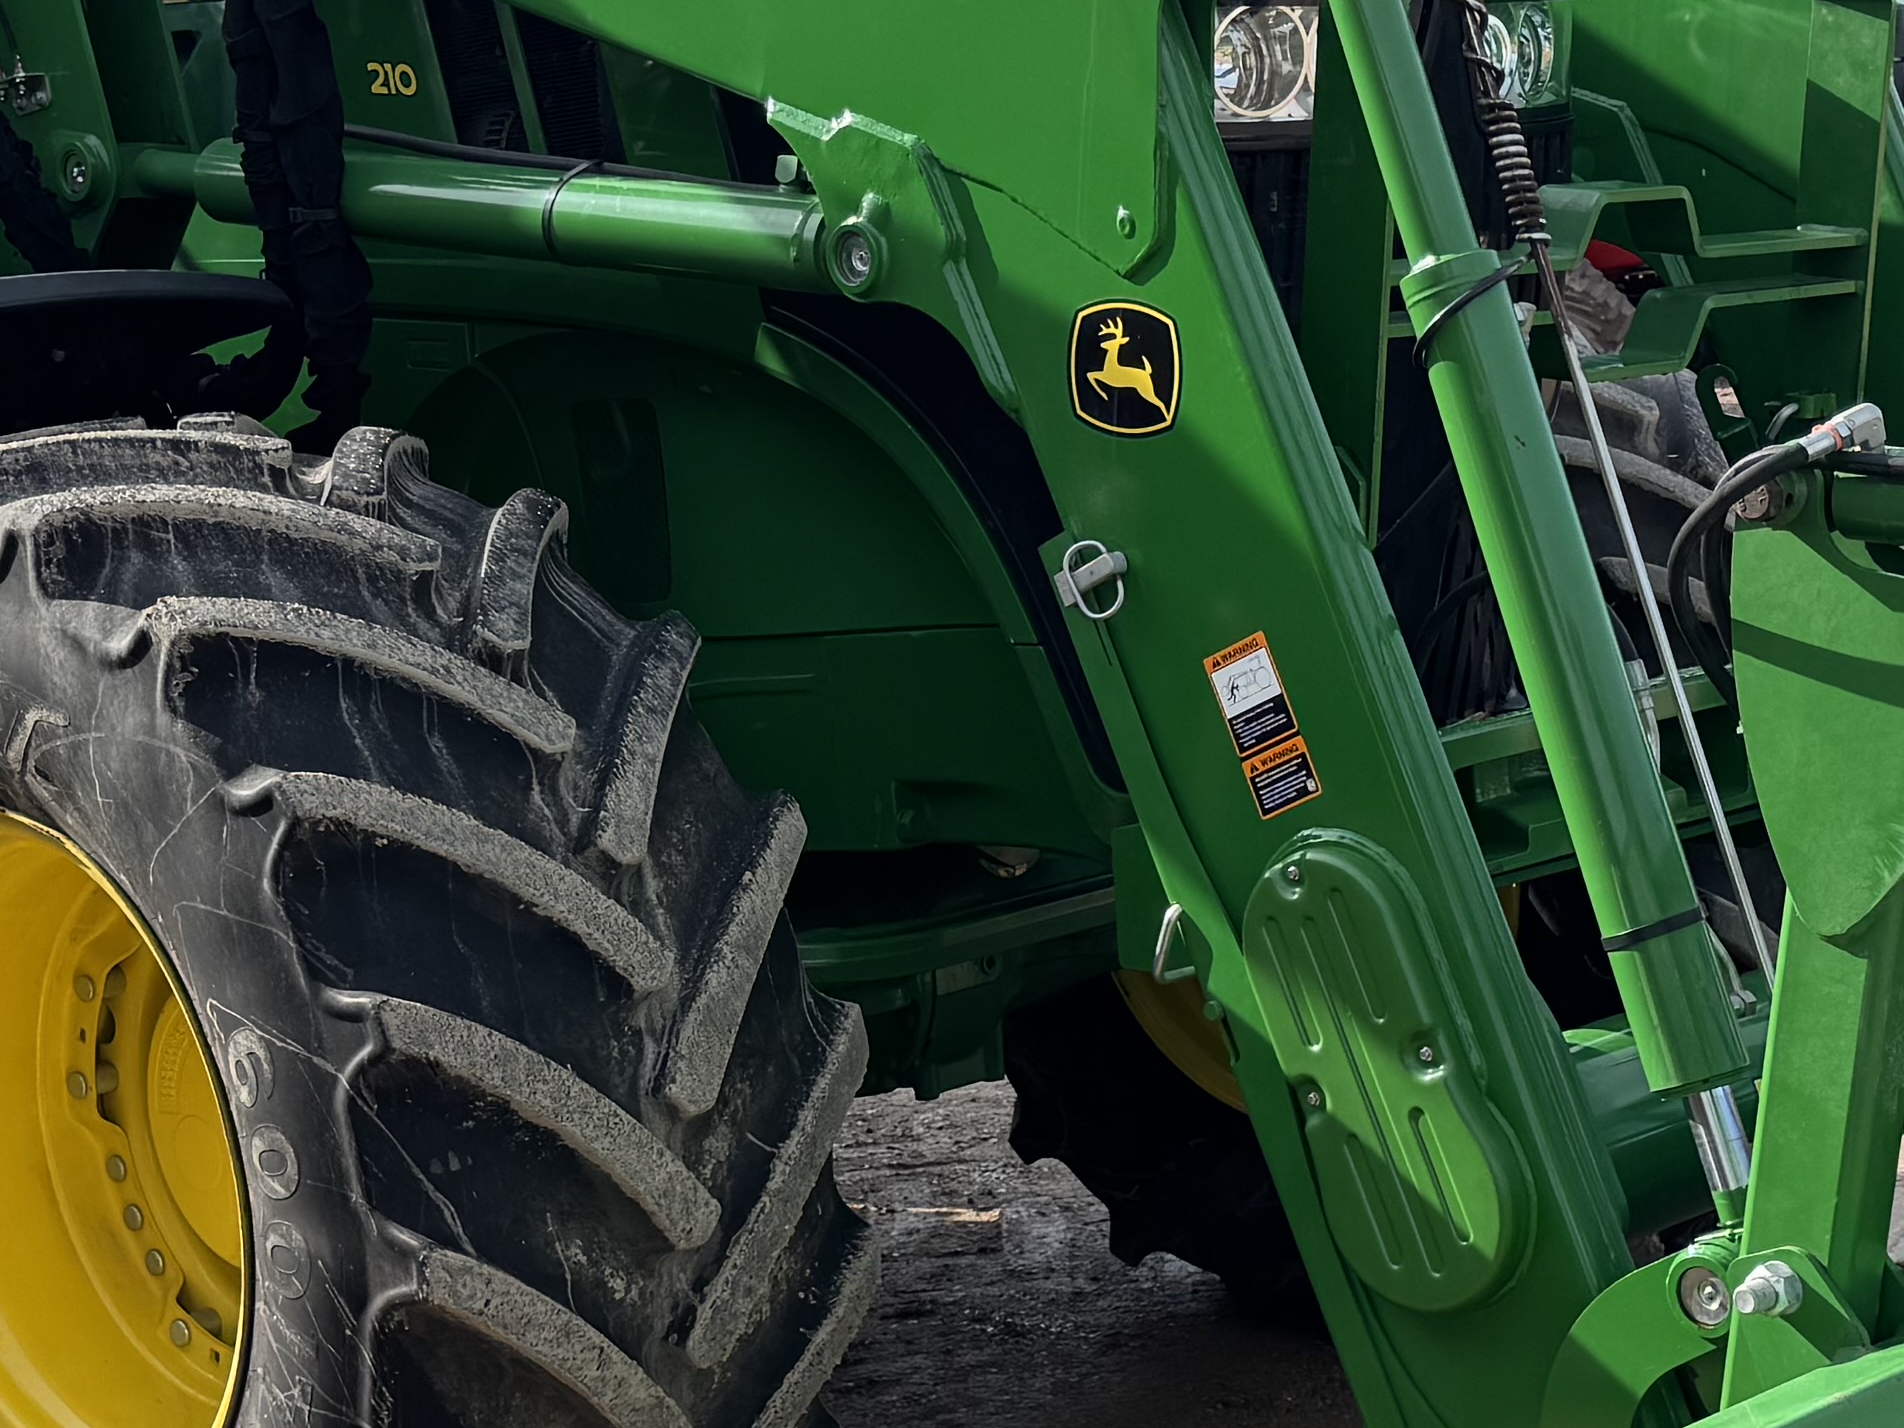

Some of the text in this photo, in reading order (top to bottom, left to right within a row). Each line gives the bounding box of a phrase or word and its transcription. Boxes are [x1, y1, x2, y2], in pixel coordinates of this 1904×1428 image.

[366, 61, 417, 97] 210
[1220, 638, 1258, 663] WARNING
[1259, 744, 1299, 767] WARNING
